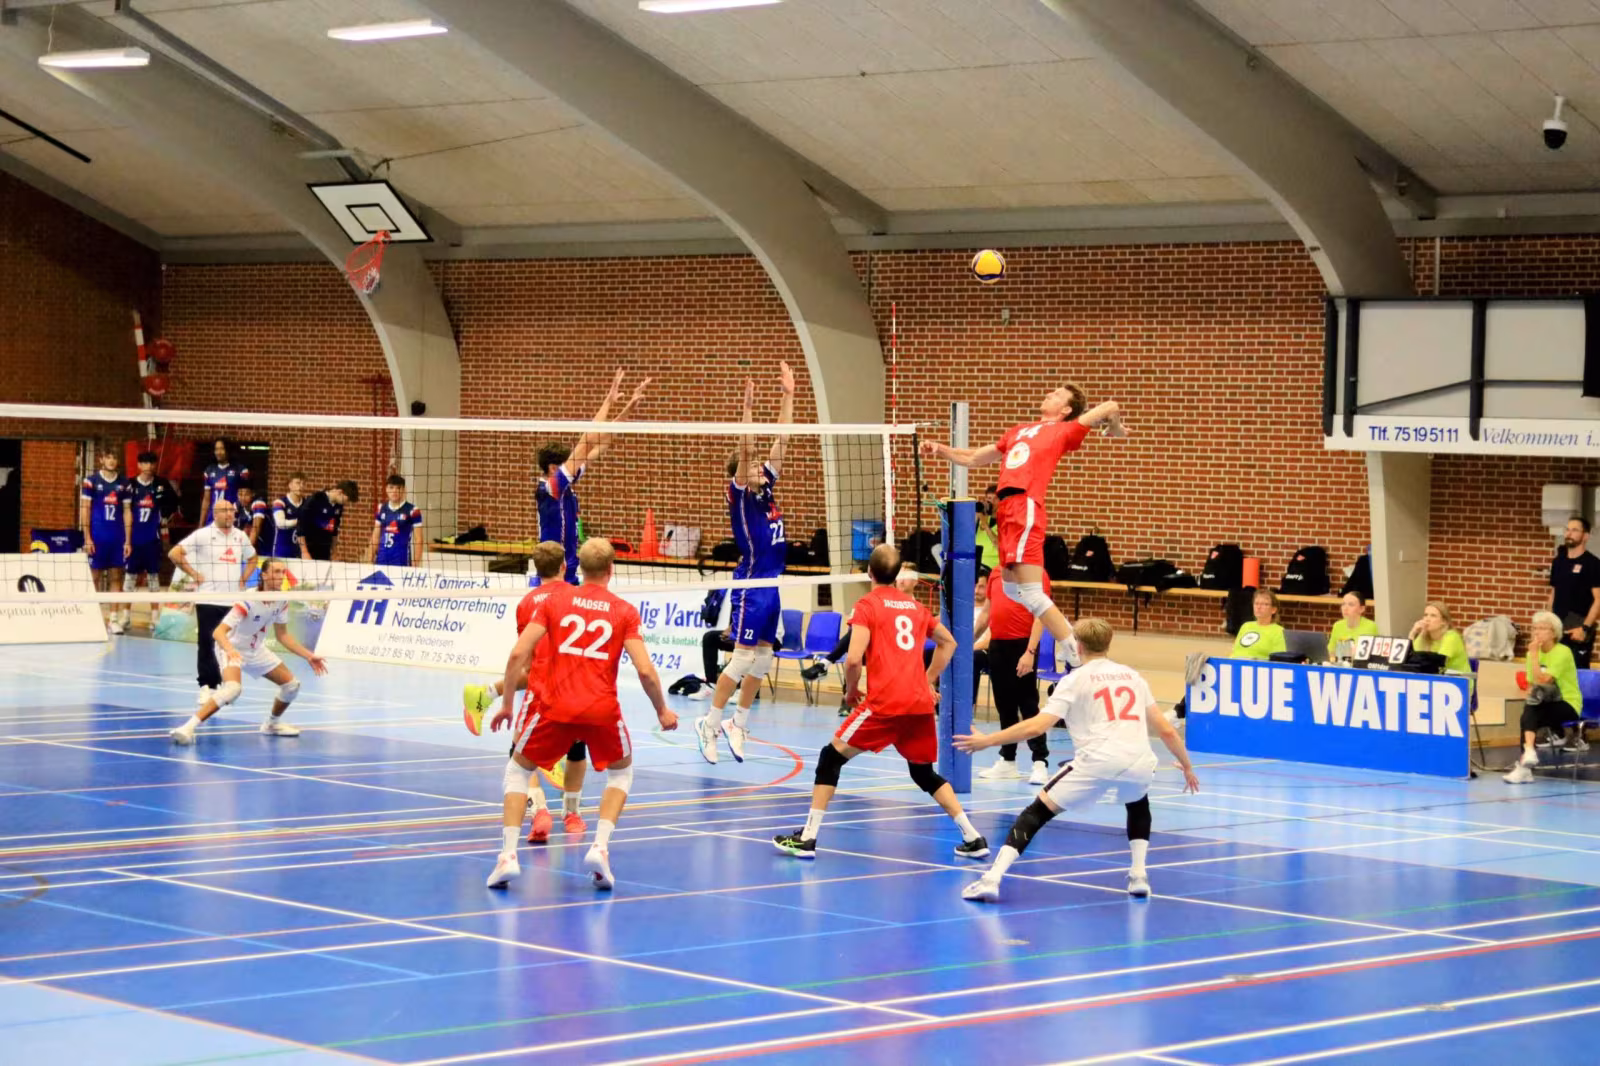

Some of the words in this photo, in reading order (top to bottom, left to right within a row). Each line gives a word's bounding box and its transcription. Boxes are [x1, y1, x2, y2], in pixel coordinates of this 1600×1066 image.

[1368, 426, 1389, 441] Tlf.
[1483, 428, 1579, 446] Velkommen
[104, 504, 116, 521] 12
[139, 507, 151, 522] 17
[384, 532, 396, 548] 15
[770, 520, 785, 546] 22
[402, 571, 428, 588] H.H.
[572, 596, 610, 612] MADSEN
[391, 611, 466, 632] Nordenskov
[640, 601, 660, 629] lig
[558, 613, 613, 660] 22
[744, 628, 754, 640] 22
[895, 615, 915, 650] 8
[1358, 640, 1369, 658] 3
[1393, 643, 1404, 661] 2
[666, 654, 682, 670] 24
[1089, 672, 1133, 683] PETERSEN
[1093, 686, 1141, 723] 12
[1190, 662, 1294, 722] BLUE
[1307, 671, 1464, 738] WATER
